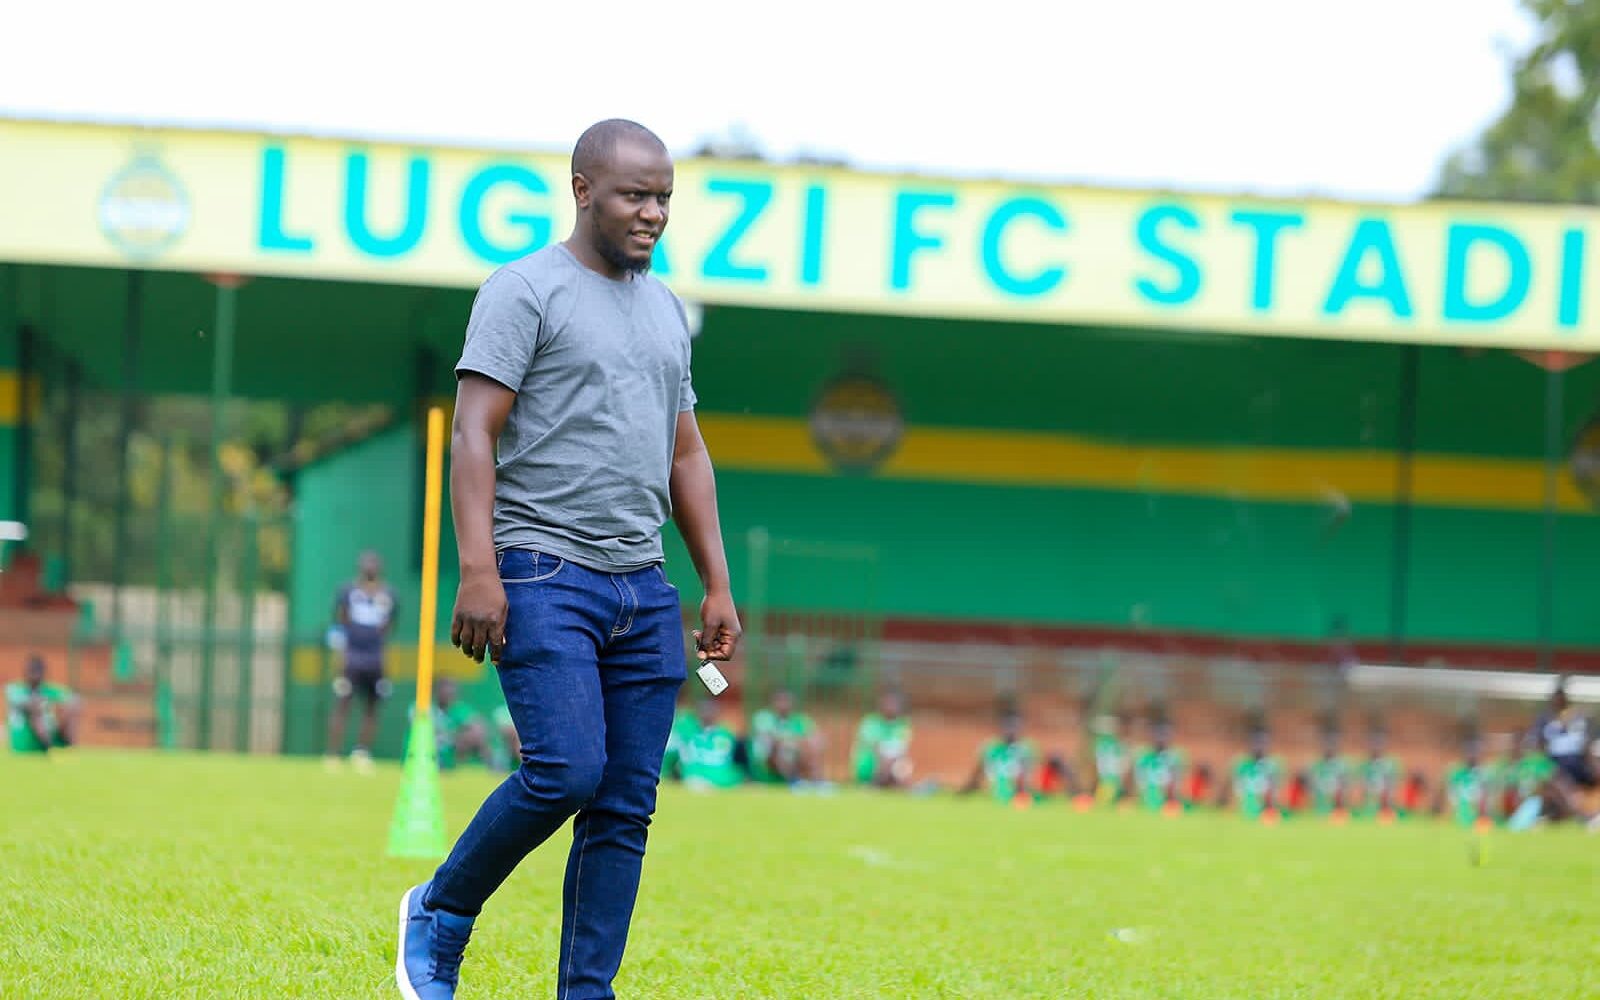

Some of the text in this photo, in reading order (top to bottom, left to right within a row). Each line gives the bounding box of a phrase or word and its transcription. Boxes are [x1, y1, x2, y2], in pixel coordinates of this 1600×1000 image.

[256, 143, 1586, 330] LUGZI FC STADI
